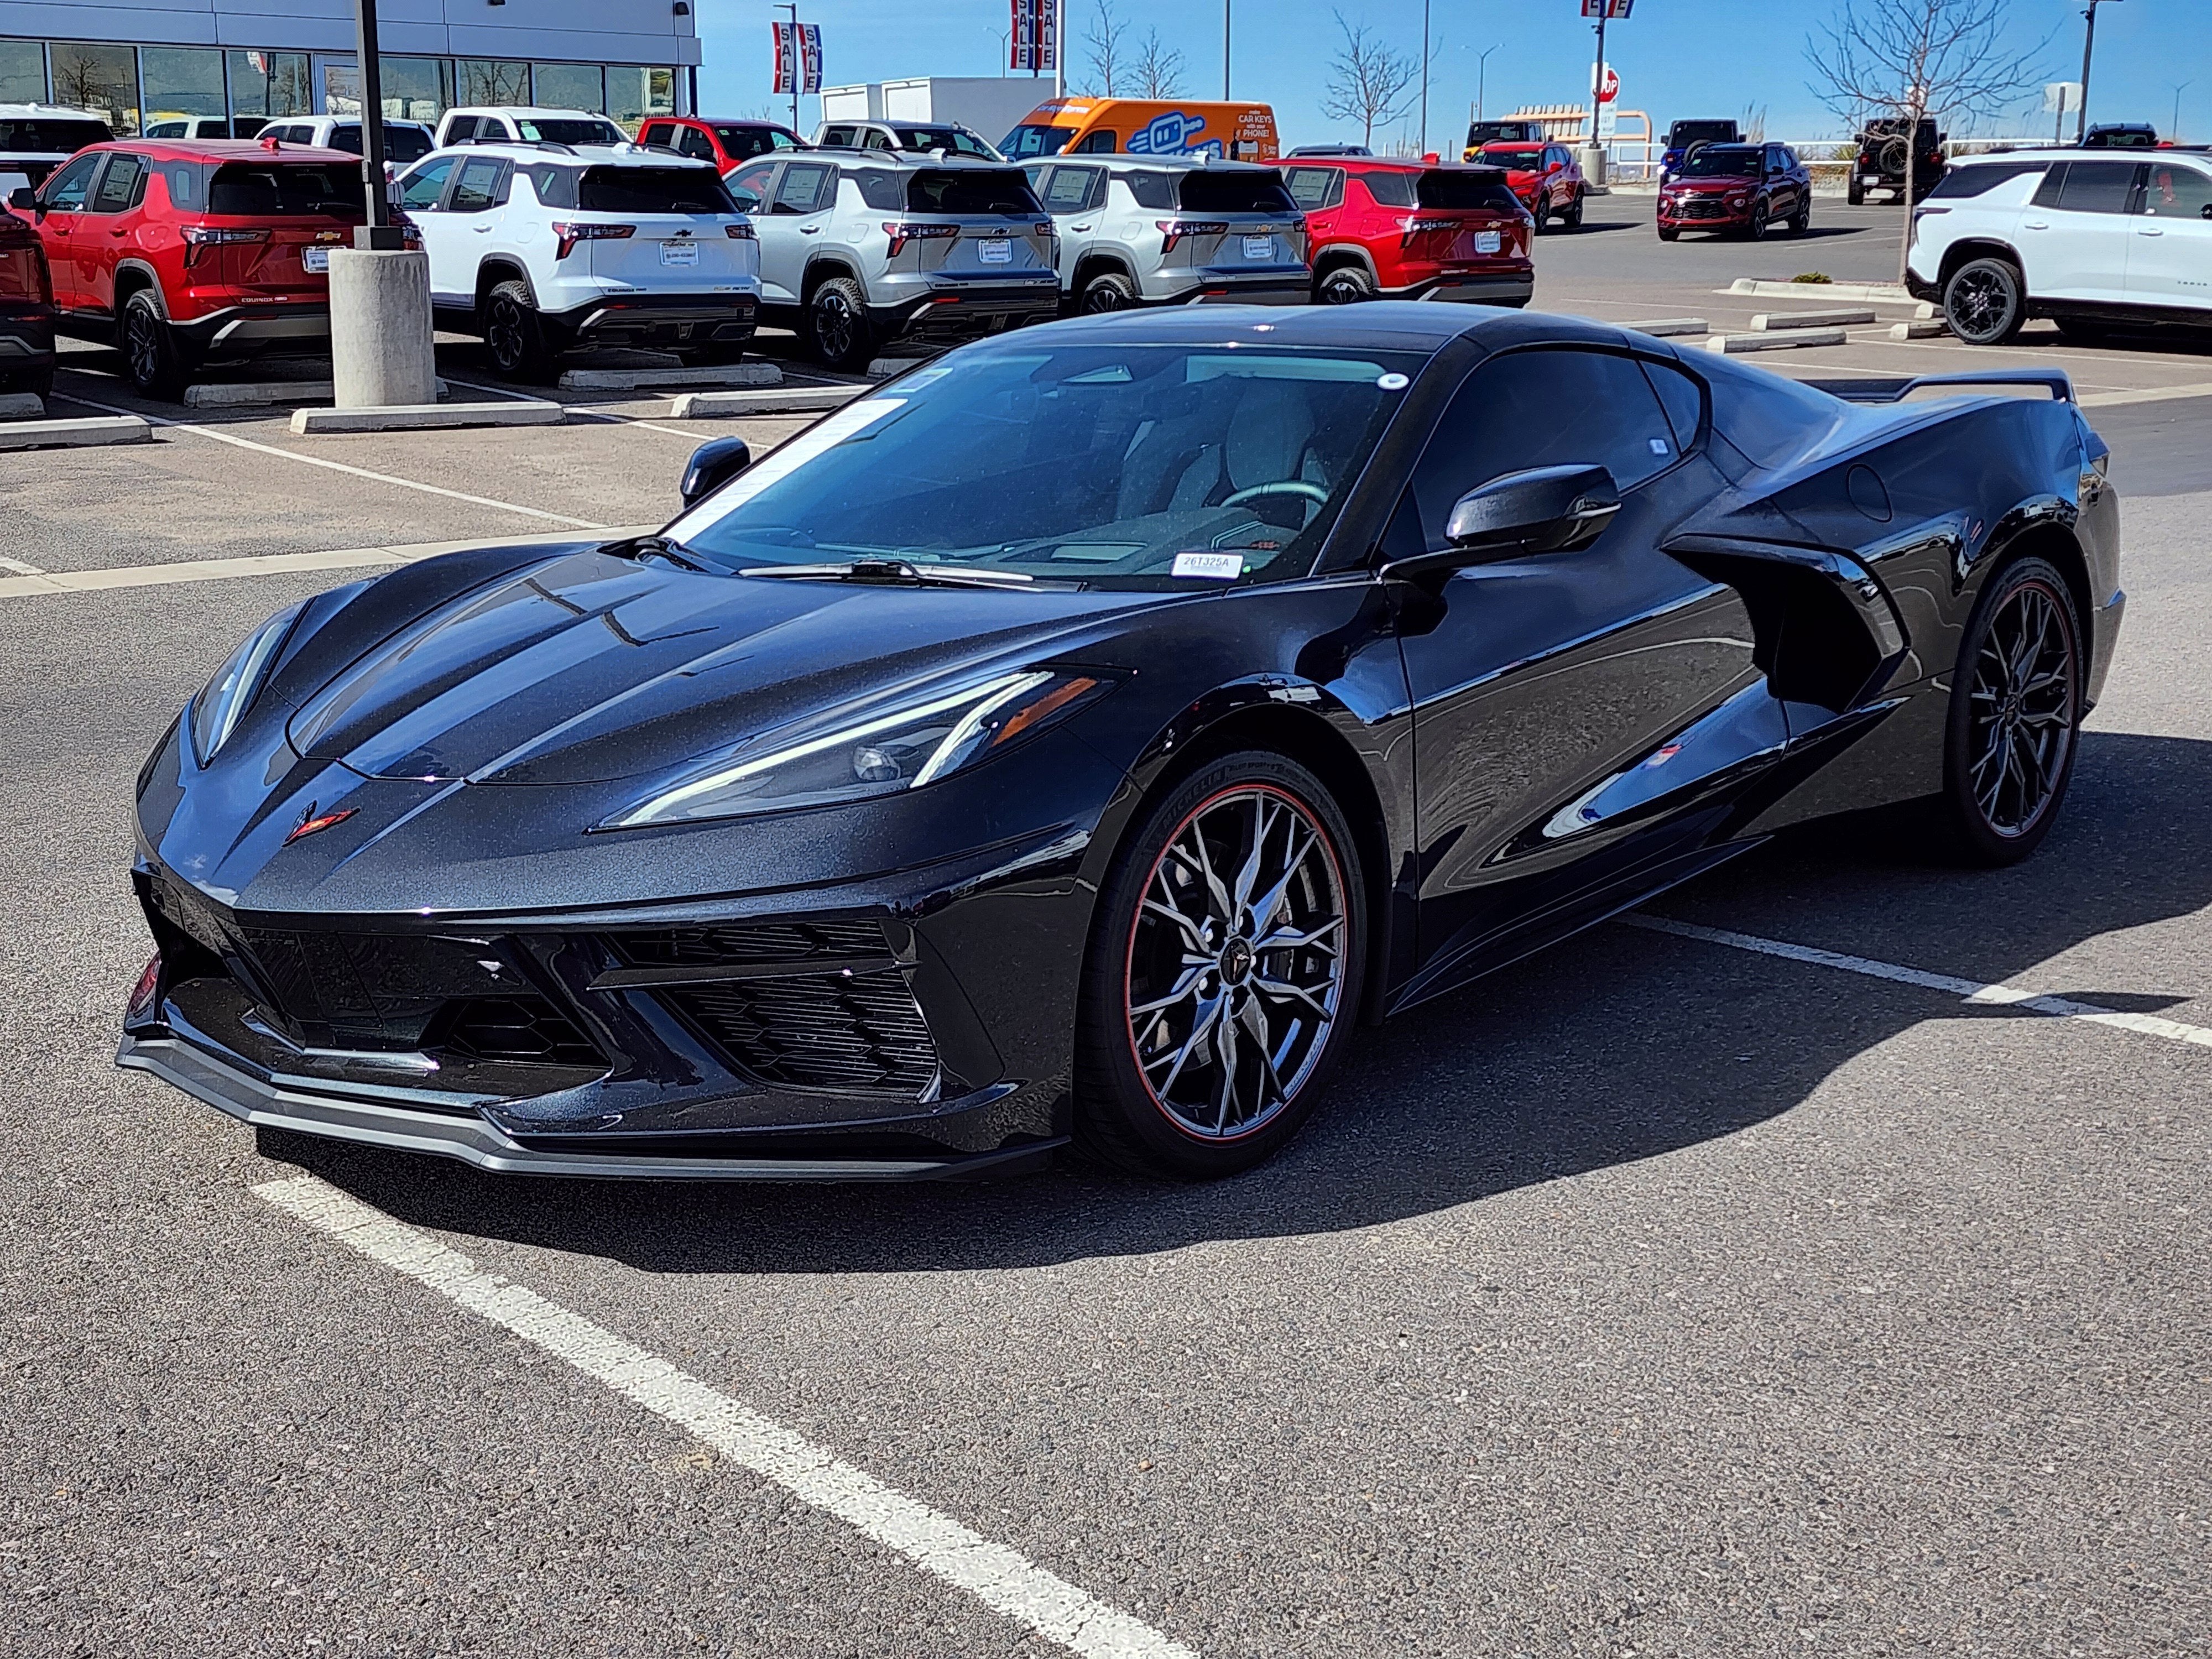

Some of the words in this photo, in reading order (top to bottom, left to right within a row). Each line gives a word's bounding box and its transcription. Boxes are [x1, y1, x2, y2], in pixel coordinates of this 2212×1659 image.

[781, 28, 791, 88] SALE
[806, 29, 817, 88] SALE
[1019, 0, 1027, 62] SALE
[1044, 0, 1053, 63] SALE
[1239, 114, 1254, 123] CAR
[1254, 115, 1272, 123] KEYS
[1184, 556, 1229, 566] 26T325A
